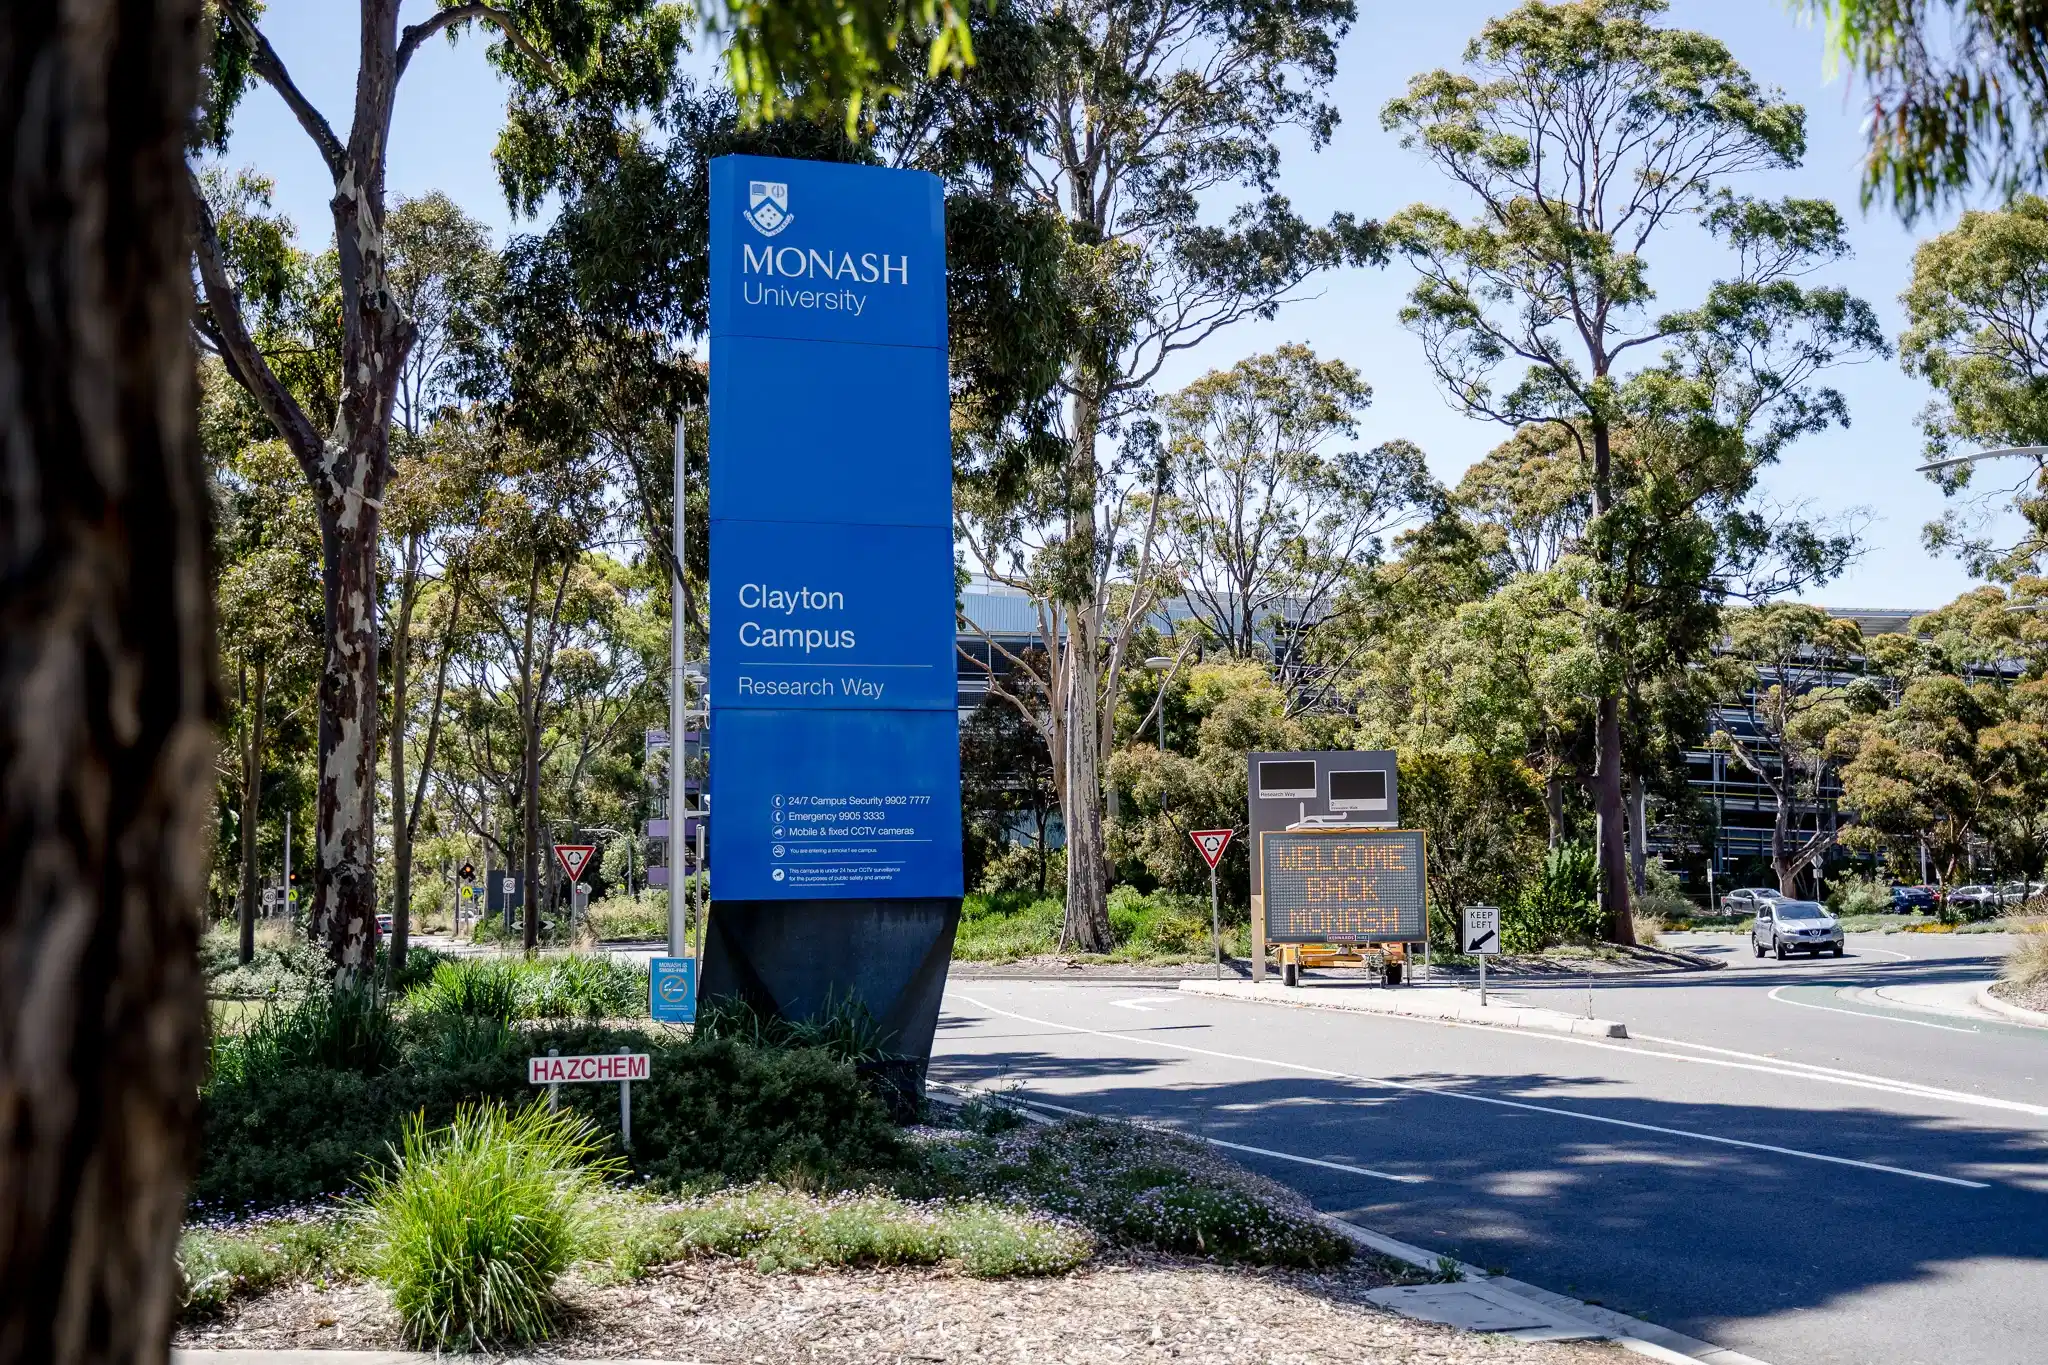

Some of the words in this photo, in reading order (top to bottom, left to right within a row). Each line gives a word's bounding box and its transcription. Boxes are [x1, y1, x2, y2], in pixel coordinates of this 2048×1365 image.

[743, 244, 908, 285] MONASH
[744, 282, 866, 316] University
[739, 584, 844, 615] Clayton
[739, 622, 856, 653] Campus
[739, 676, 834, 695] Research
[841, 678, 884, 700] Way
[788, 796, 808, 805] 24/7
[811, 796, 847, 806] Campus
[849, 796, 883, 807] Security
[885, 796, 907, 805] 9902
[909, 796, 930, 804] 7777
[788, 812, 836, 822] Emergency
[838, 812, 861, 821] 9905
[863, 812, 885, 820] 3333
[789, 827, 818, 836] Mobile
[820, 827, 826, 836] &
[828, 827, 848, 836] fixed
[850, 827, 876, 835] CCTV
[1280, 844, 1407, 870] WELCOME
[1307, 877, 1379, 902] BACK
[1290, 908, 1398, 933] MONASH
[533, 1056, 646, 1081] HAZCHEM
